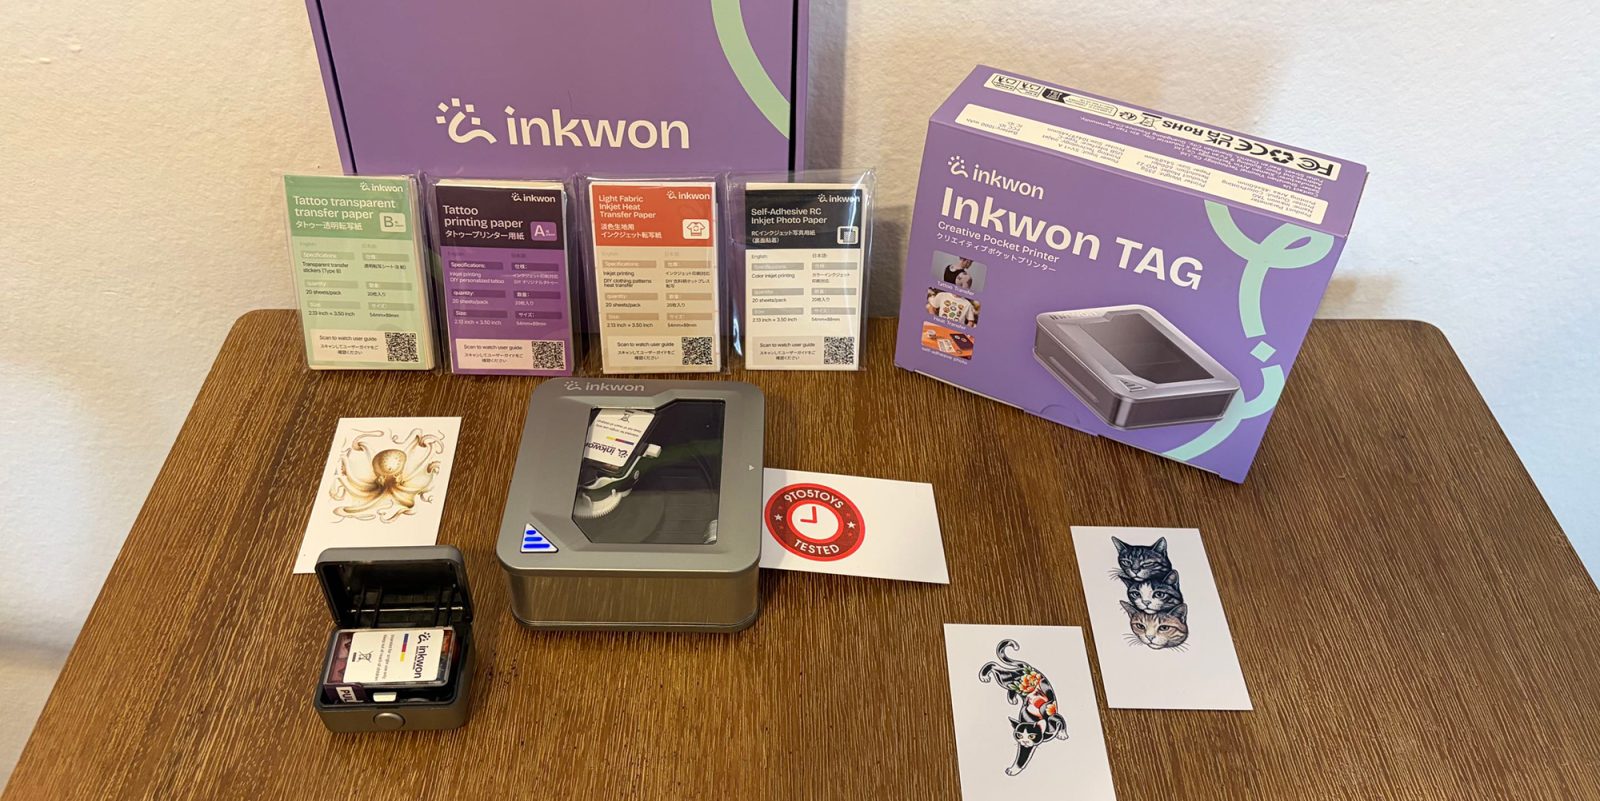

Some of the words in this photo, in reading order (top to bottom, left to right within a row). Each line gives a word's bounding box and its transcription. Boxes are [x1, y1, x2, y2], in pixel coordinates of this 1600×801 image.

[504, 106, 689, 148] inkwon
[1161, 119, 1203, 136] RoHS
[1204, 135, 1232, 148] UK
[972, 164, 1044, 199] inkwon
[371, 184, 403, 192] inkwon
[523, 194, 556, 203] inkwon
[598, 195, 618, 203] Light
[679, 192, 710, 200] inkwon
[293, 196, 328, 206] Tattoo
[331, 198, 396, 209] transparent
[599, 203, 621, 211] Inkjet
[295, 208, 339, 218] transfer
[342, 211, 374, 220] paper
[442, 205, 478, 215] Tattoo
[383, 216, 394, 228] B
[444, 217, 488, 229] printing
[490, 220, 523, 229] paper
[751, 217, 774, 225] Inkjet
[803, 217, 828, 225] Paper
[445, 230, 525, 240] タトゥープリンター用紙
[534, 225, 545, 237] A
[938, 221, 981, 240] Creative
[983, 231, 1020, 252] Pocket
[1022, 243, 1060, 263] Printer
[941, 187, 1101, 260] Inkwon
[1115, 236, 1204, 290] TAG
[936, 232, 1057, 271] クリエイティブポケットプリンター
[586, 382, 644, 392] inkwon
[784, 489, 843, 509] 9TO5TOYS
[794, 539, 839, 555] TESTED
[414, 646, 429, 678] inkwon
